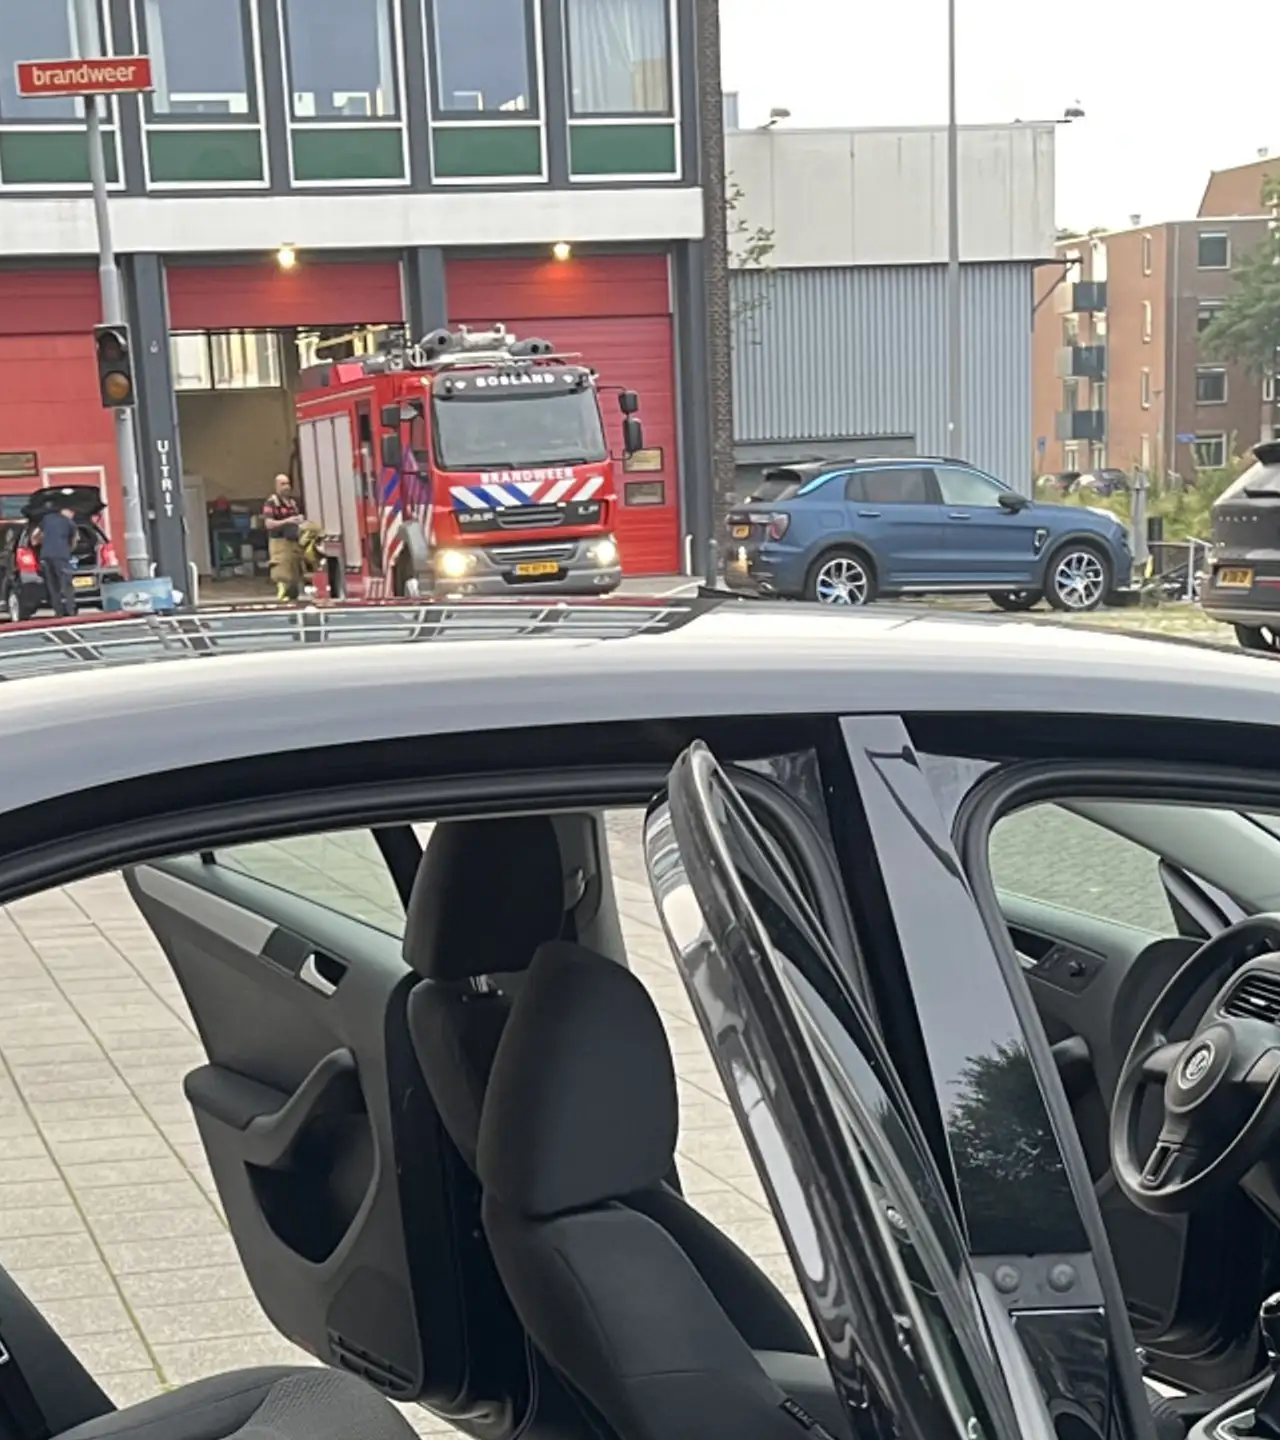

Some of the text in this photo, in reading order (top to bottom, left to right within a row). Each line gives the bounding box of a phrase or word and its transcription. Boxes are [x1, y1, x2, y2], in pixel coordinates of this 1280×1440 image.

[32, 64, 137, 86] brandweer
[156, 440, 174, 518] UITRIT
[480, 467, 574, 484] BRANDWEER
[459, 512, 494, 523] DAF
